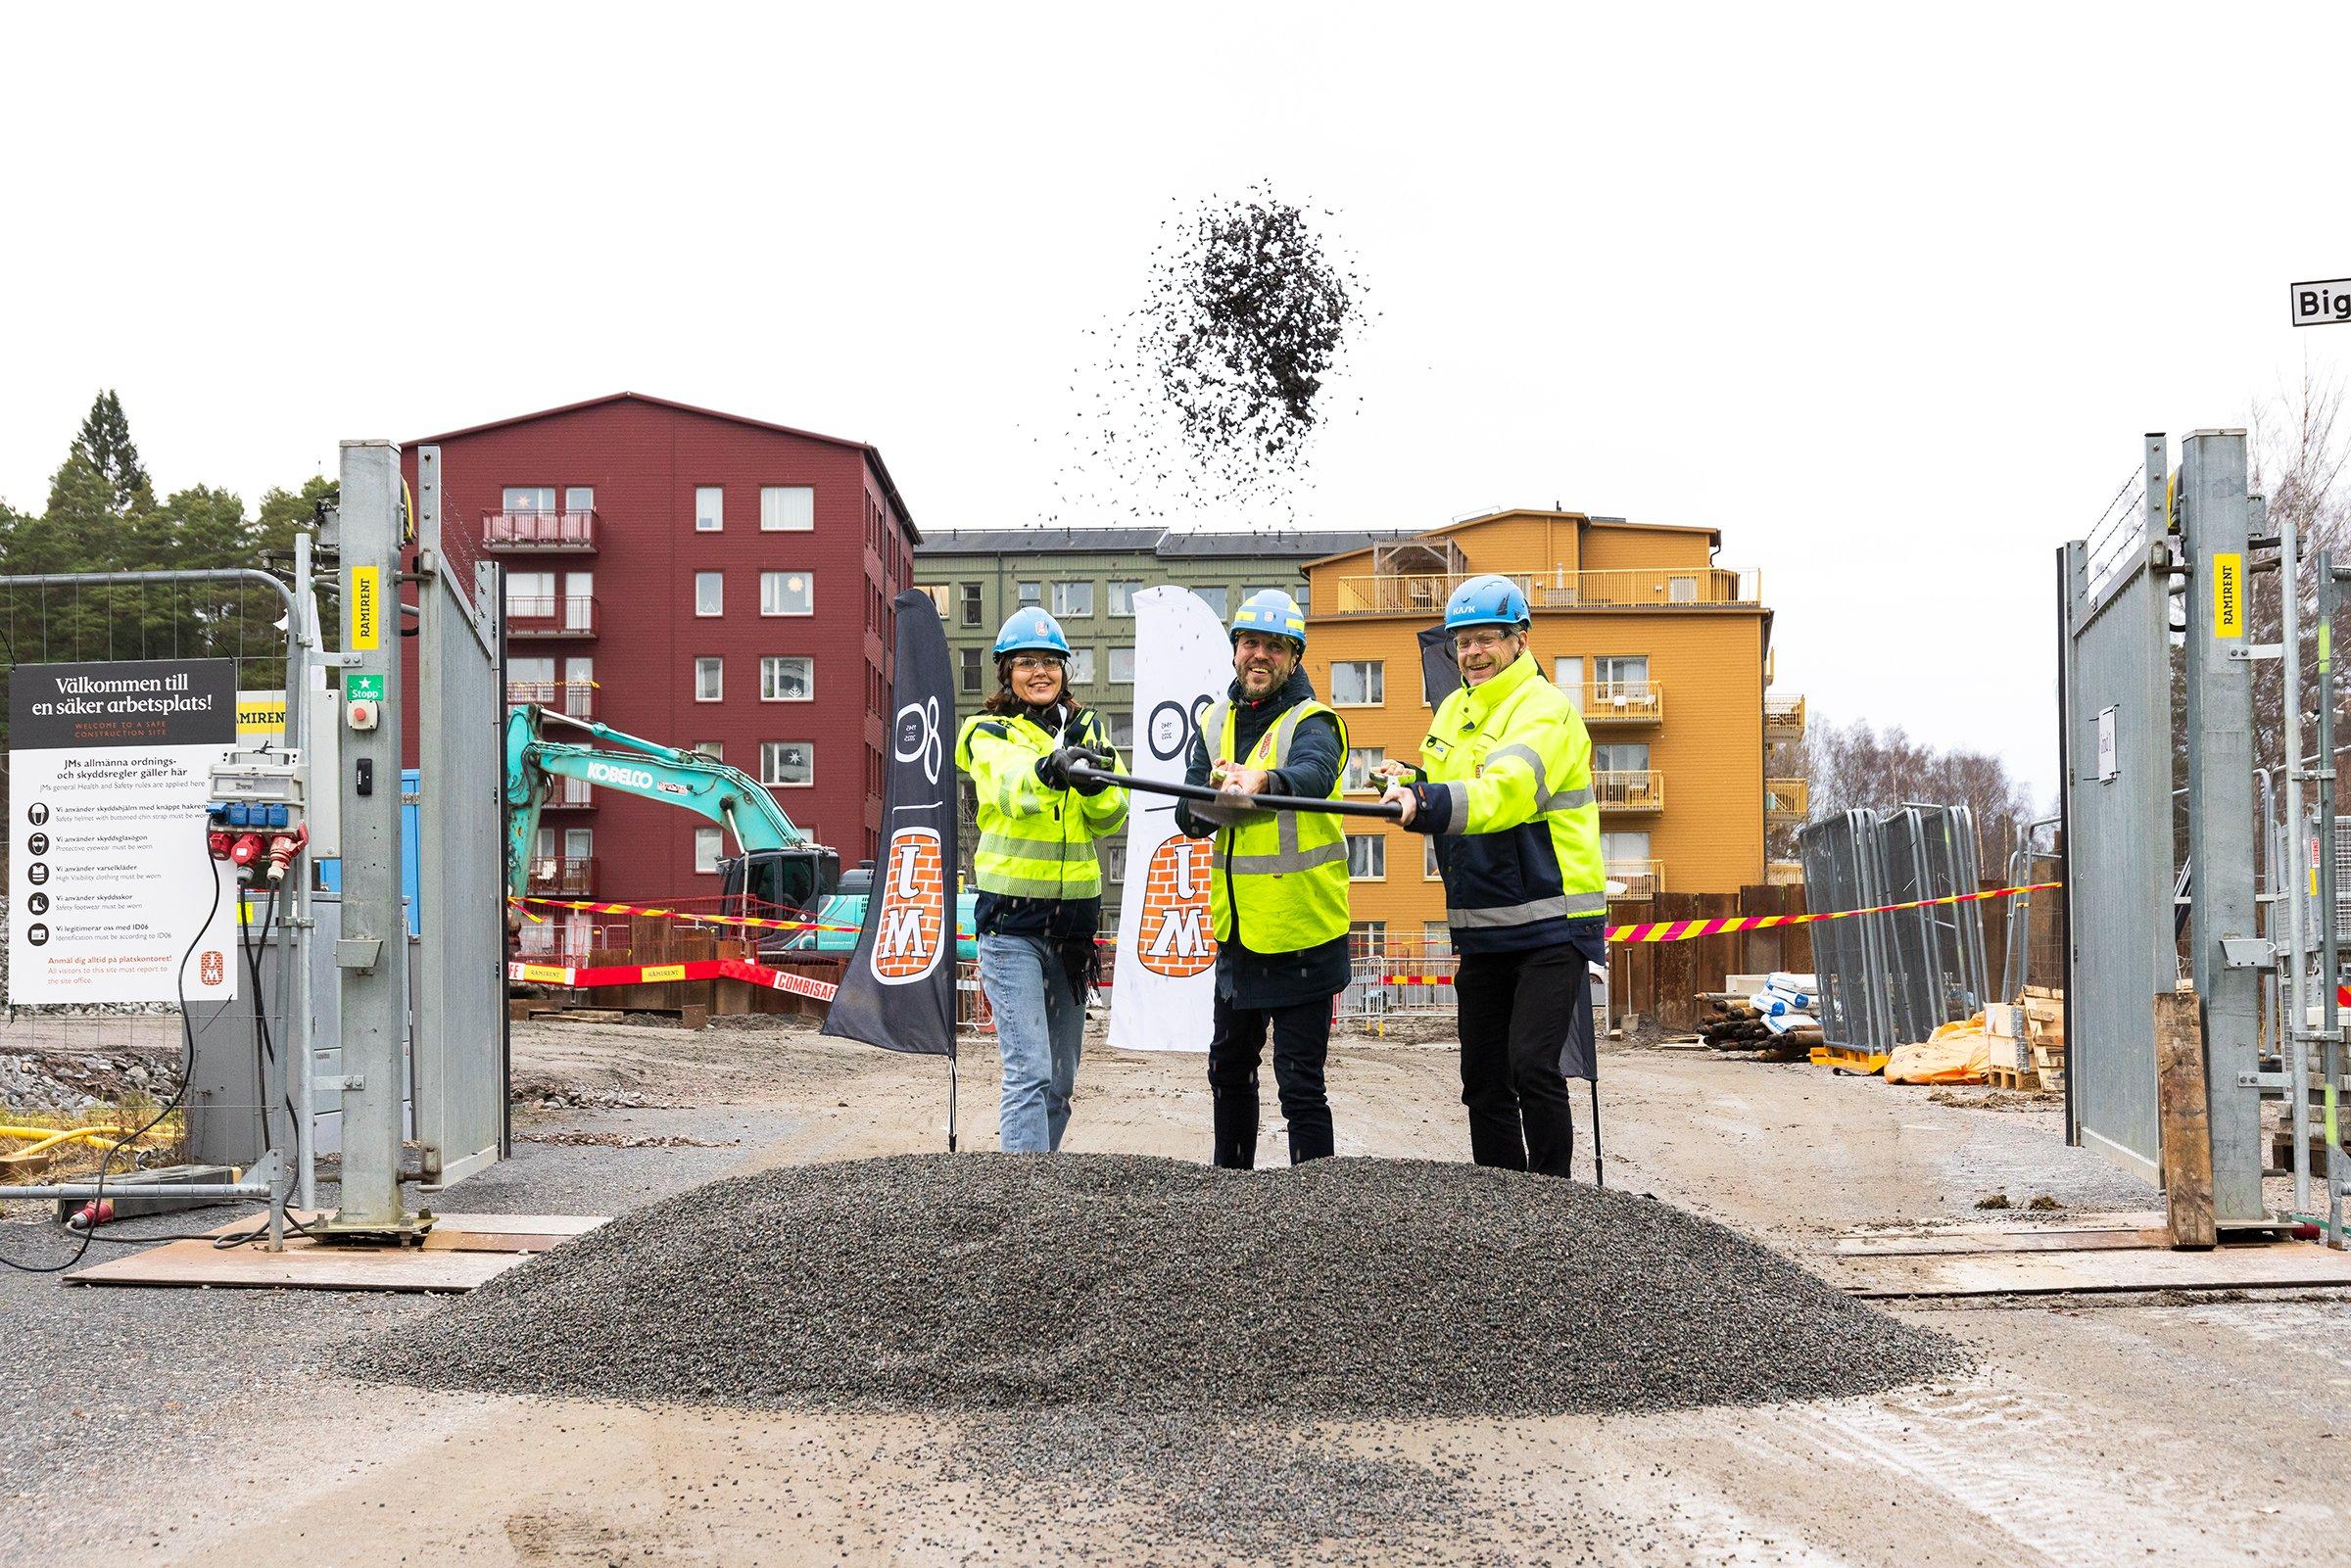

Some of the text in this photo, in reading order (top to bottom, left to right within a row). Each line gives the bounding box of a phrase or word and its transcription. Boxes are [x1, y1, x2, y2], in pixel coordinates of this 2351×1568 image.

[2300, 289, 2351, 319] Big
[2223, 566, 2233, 625] RAMIRENT
[360, 578, 370, 637] RAMIRENT
[56, 673, 188, 694] Välkommen till
[352, 689, 378, 699] Stopp
[32, 694, 212, 716] en säker arbetsplats!
[237, 712, 286, 724] MIREN
[64, 756, 177, 770] JMs allmänna ordnings-
[57, 767, 187, 781] och skyddsregler gäller här
[588, 762, 653, 789] KOBELCO
[530, 970, 559, 978] RAMIRENT
